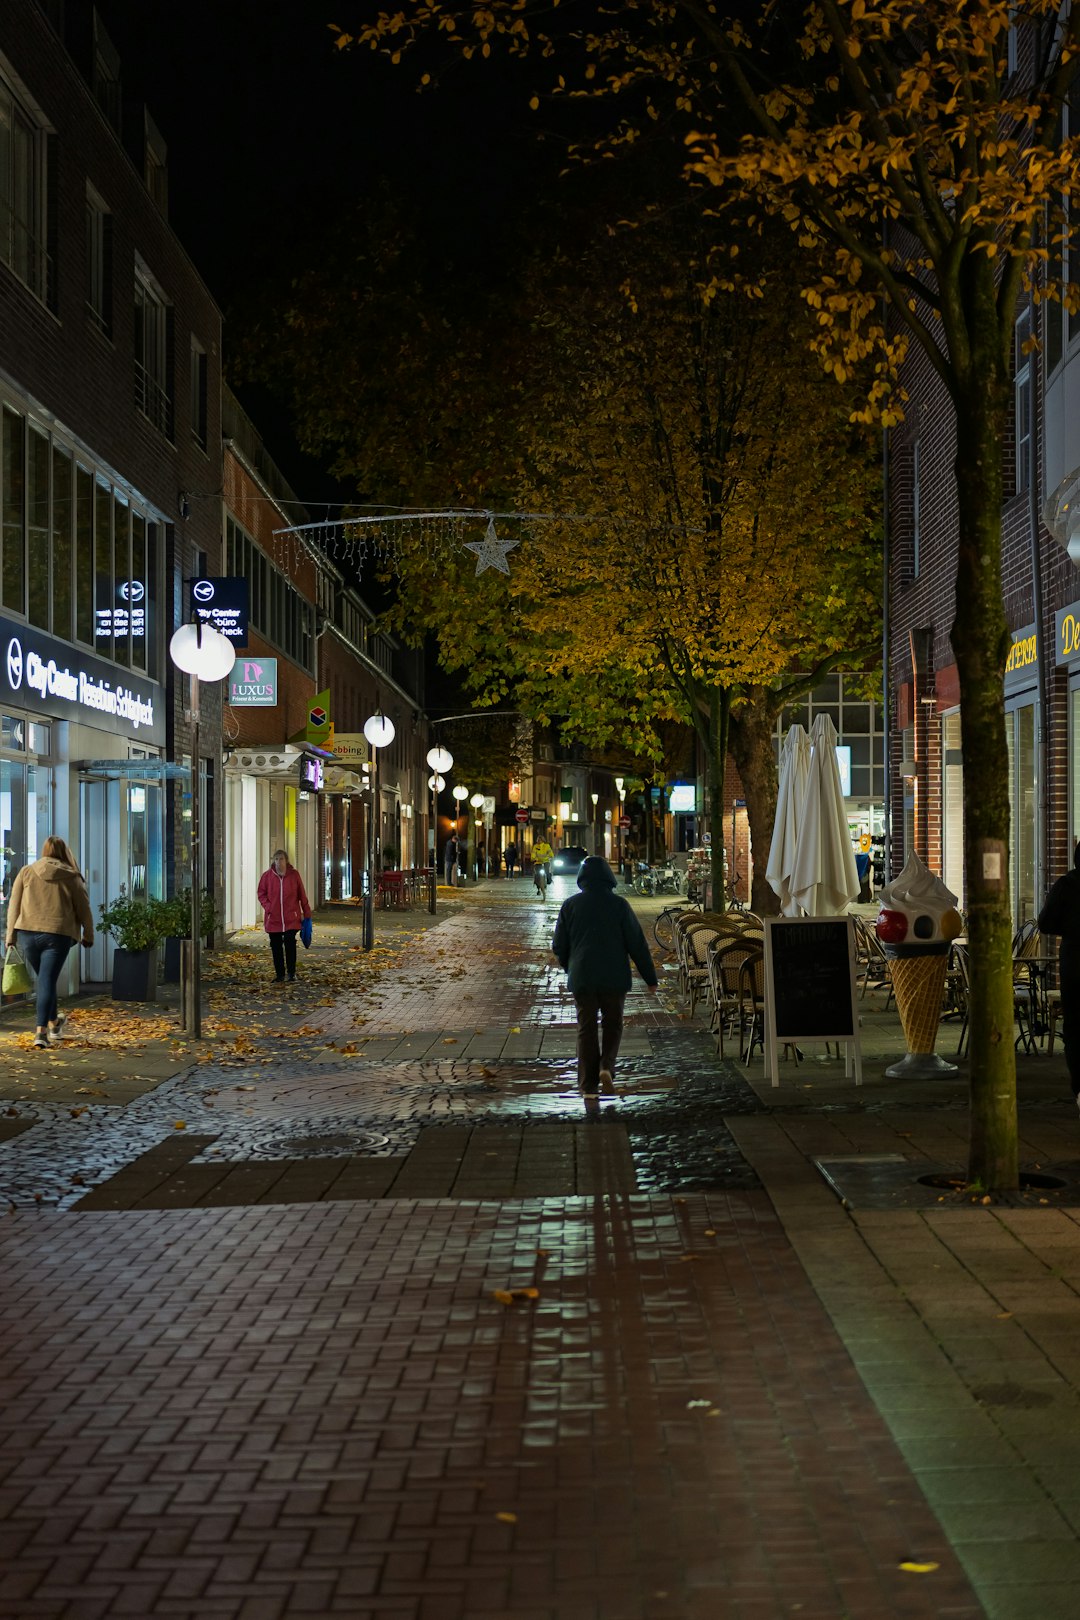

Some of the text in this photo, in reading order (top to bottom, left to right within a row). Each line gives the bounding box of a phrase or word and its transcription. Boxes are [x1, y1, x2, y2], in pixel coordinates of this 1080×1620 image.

[212, 608, 241, 617] Center
[27, 652, 47, 698] City
[48, 660, 78, 701] Center
[80, 671, 116, 714] Reisebüro
[232, 683, 273, 696] LUXUS
